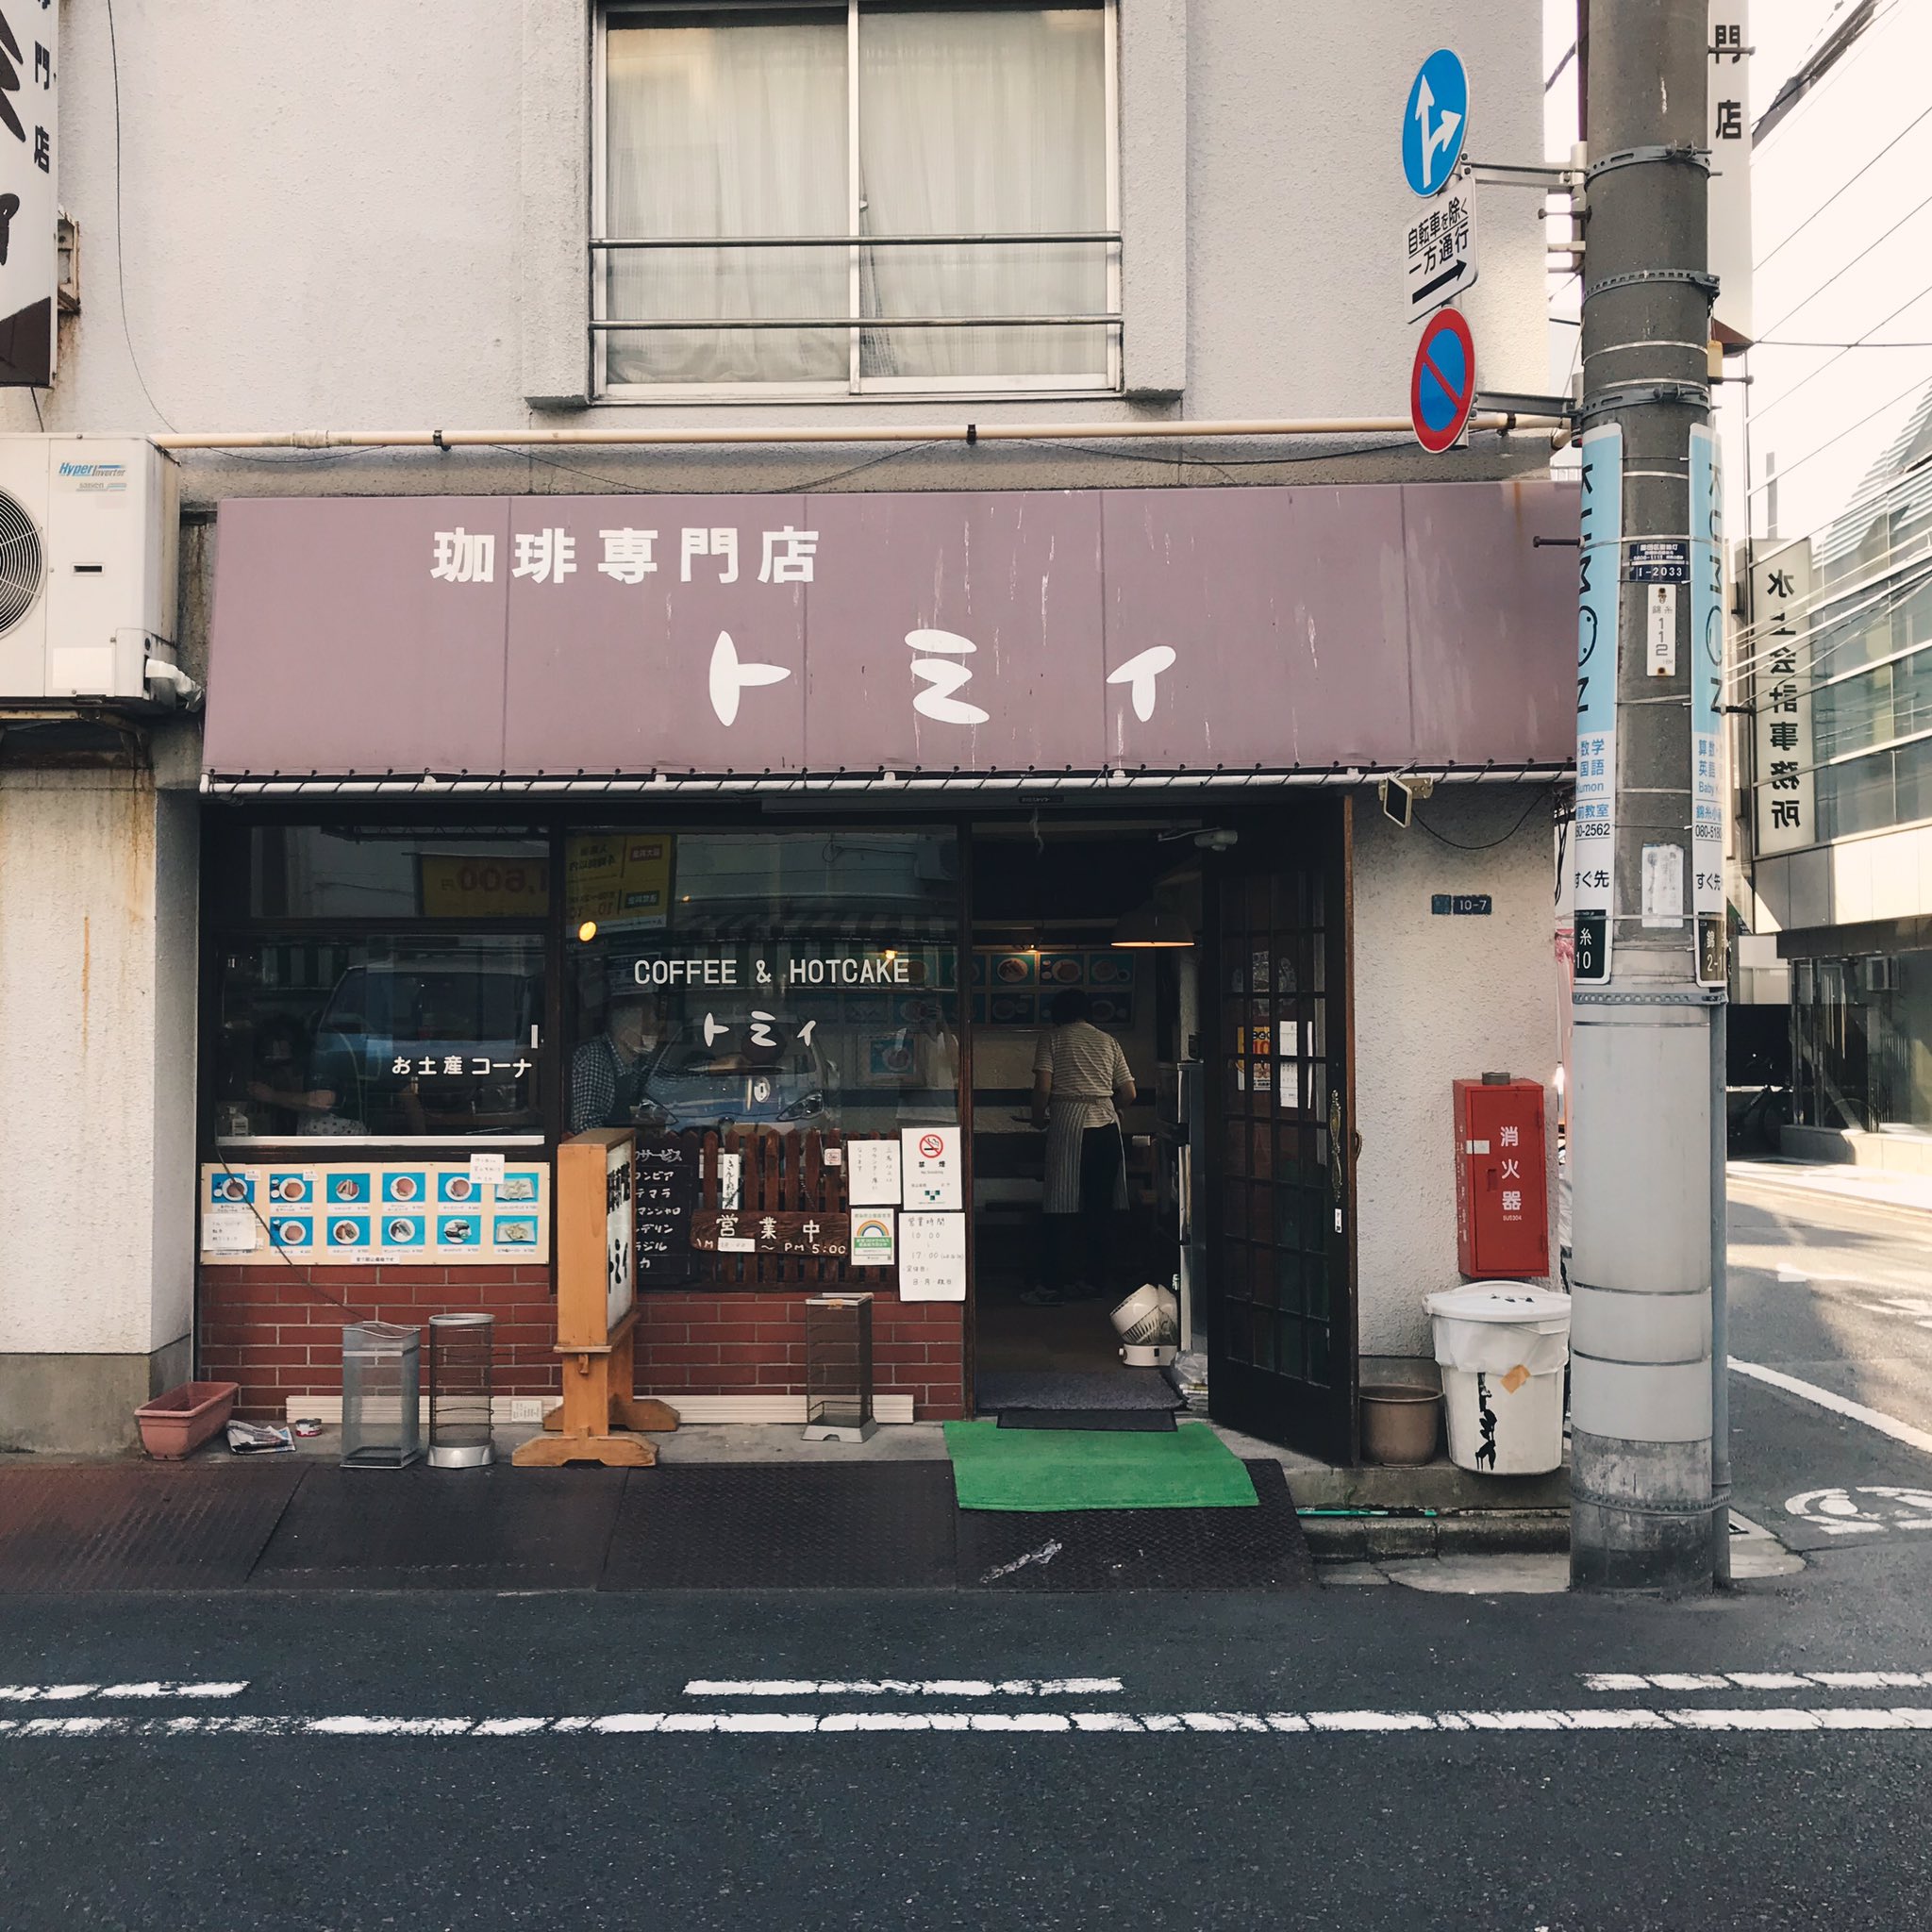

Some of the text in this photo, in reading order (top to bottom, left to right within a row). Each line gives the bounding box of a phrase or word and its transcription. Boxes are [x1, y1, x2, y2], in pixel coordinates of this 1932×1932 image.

[34, 0, 50, 174] 門店
[1715, 25, 1741, 140] 門店
[1408, 197, 1468, 254] 自転車を除く
[1408, 223, 1469, 275] 一方通行
[58, 462, 125, 476] Hyper Inverter
[430, 525, 819, 584] 珈琲専門店
[709, 629, 1177, 726] トミィ
[1580, 759, 1604, 776] 国語
[1460, 900, 1487, 910] 10-7
[634, 958, 909, 984] COFFEE & HOTCAKE
[704, 1011, 816, 1047] トミィ
[1500, 1125, 1522, 1211] 消火器
[716, 1214, 820, 1243] 営業中
